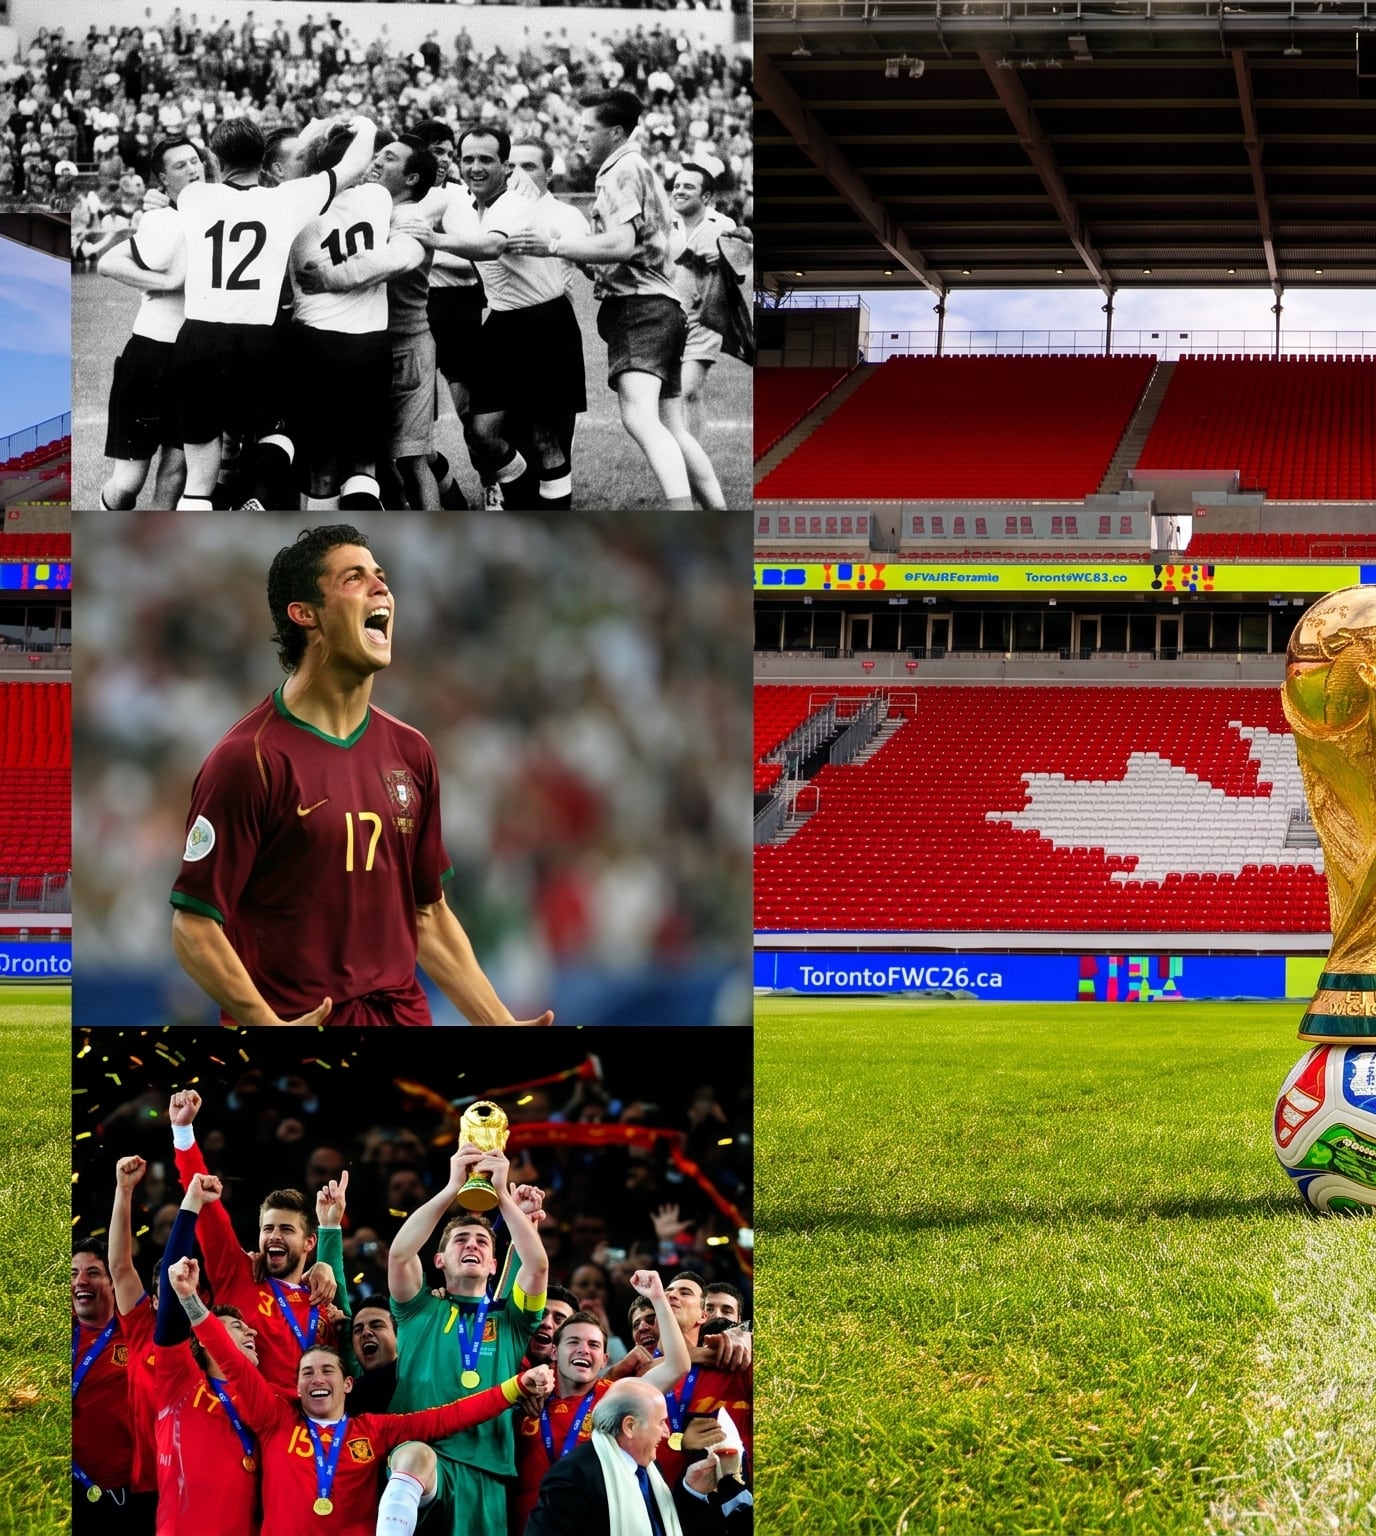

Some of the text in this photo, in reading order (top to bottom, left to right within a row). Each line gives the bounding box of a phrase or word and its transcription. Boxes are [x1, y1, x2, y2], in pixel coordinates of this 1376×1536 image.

[205, 220, 267, 290] 12
[346, 812, 382, 871] 17
[800, 966, 1003, 988] TorontoFWC26.ca
[444, 1306, 459, 1334] 1
[287, 1425, 315, 1458] 15
